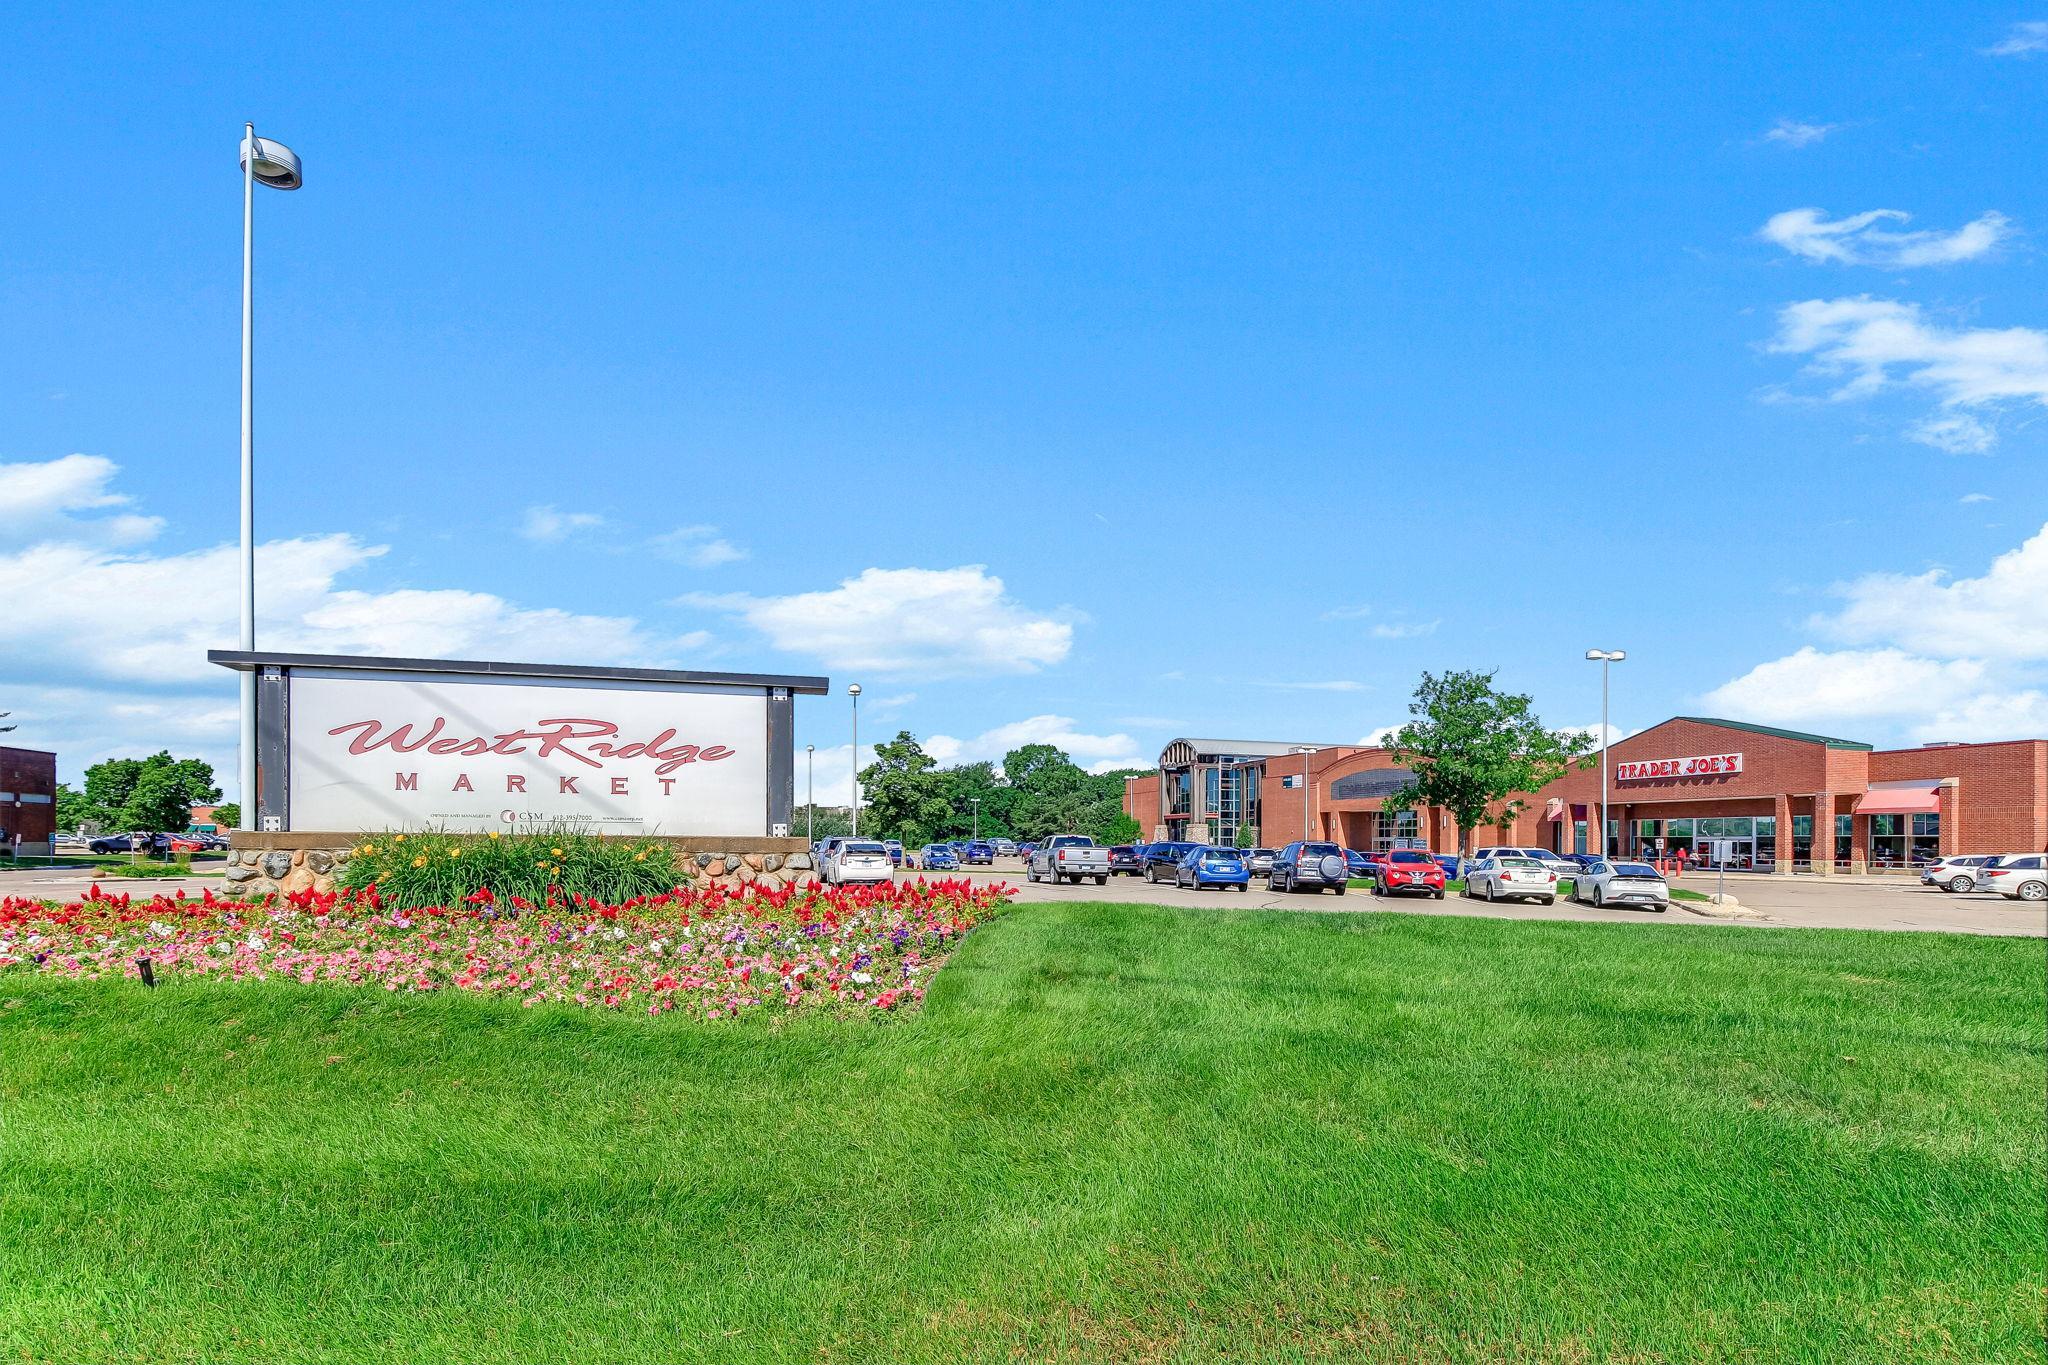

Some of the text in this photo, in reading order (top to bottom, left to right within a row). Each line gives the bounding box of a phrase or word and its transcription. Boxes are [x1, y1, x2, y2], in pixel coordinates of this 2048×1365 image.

[1620, 756, 1738, 778] TRADER JOE'S
[395, 772, 676, 796] MARKET
[519, 812, 543, 820] CSM
